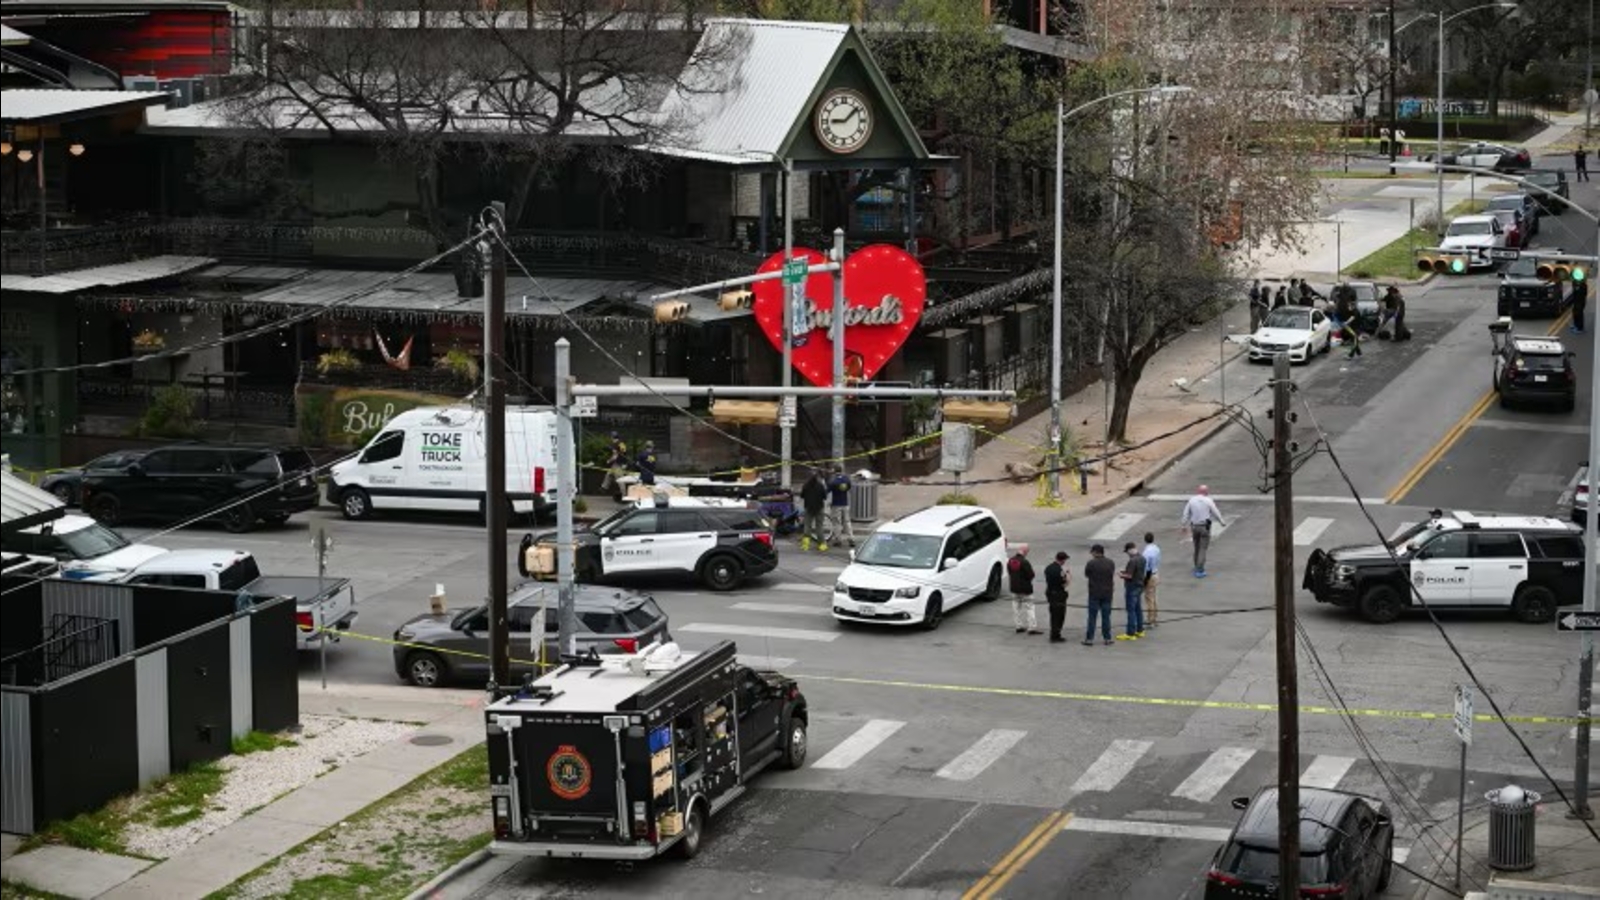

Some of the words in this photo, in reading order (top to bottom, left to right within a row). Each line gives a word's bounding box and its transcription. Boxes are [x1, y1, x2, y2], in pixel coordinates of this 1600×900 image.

[422, 432, 463, 447] TOKE
[421, 451, 462, 462] TRUCK
[1426, 576, 1466, 585] POLICE
